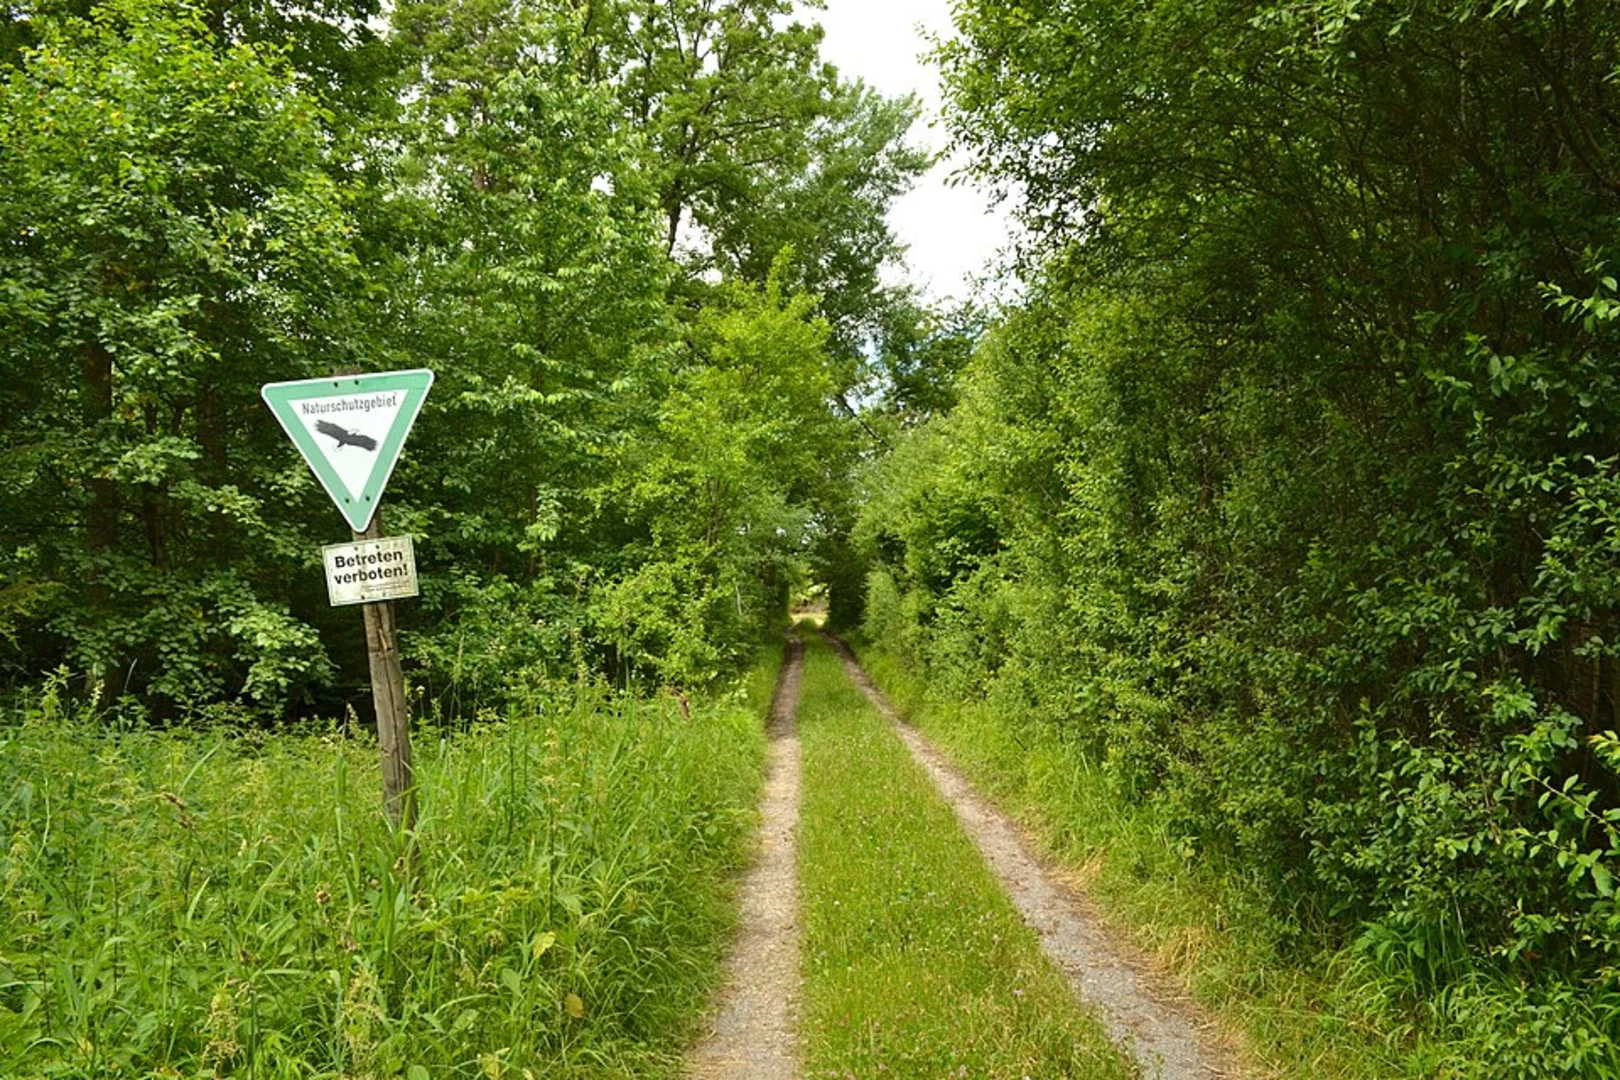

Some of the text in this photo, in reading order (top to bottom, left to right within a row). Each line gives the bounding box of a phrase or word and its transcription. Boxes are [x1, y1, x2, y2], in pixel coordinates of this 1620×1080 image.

[302, 392, 398, 415] Naturschutzgebiet
[334, 550, 403, 568] Betreten
[334, 563, 408, 584] verboten!
